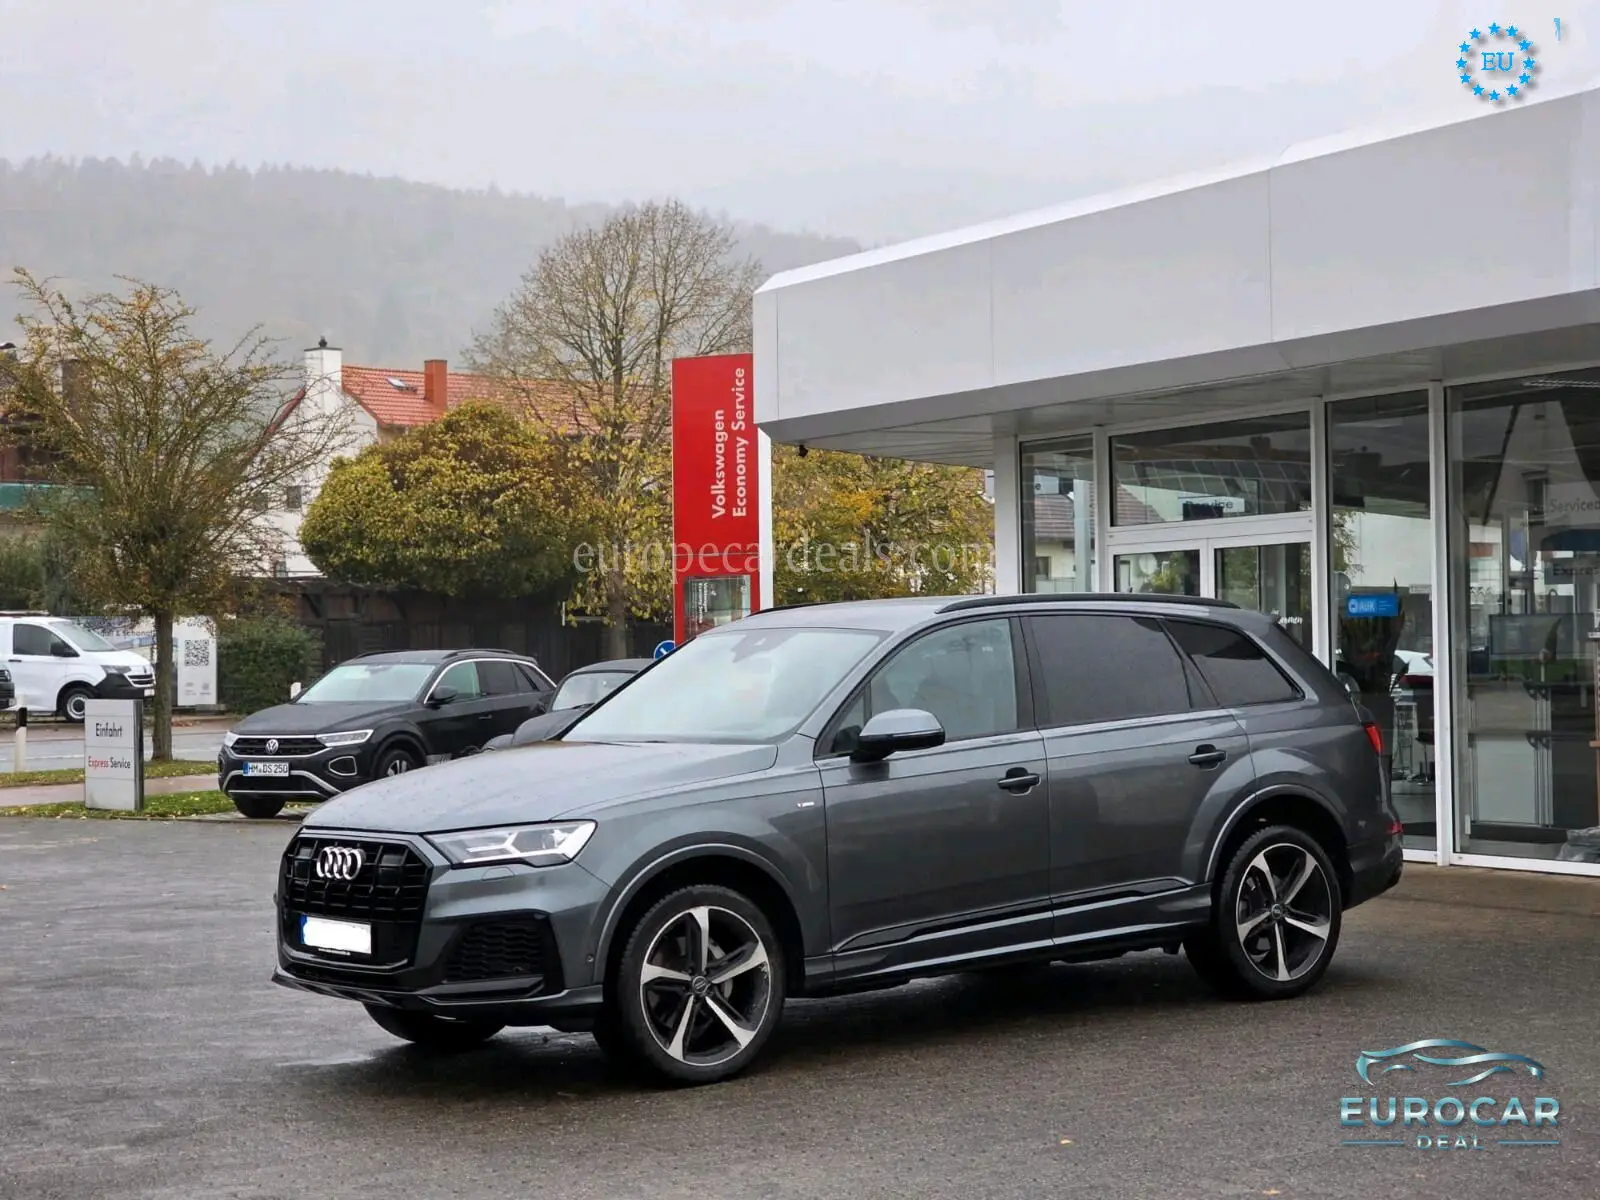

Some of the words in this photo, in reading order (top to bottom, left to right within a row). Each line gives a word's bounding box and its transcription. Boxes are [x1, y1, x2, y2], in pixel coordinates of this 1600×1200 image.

[731, 368, 746, 431] Service
[710, 409, 728, 519] Volkswagen
[732, 437, 749, 517] Economy
[95, 722, 123, 737] Einfahrt
[88, 756, 109, 769] Express
[110, 756, 131, 768] Service
